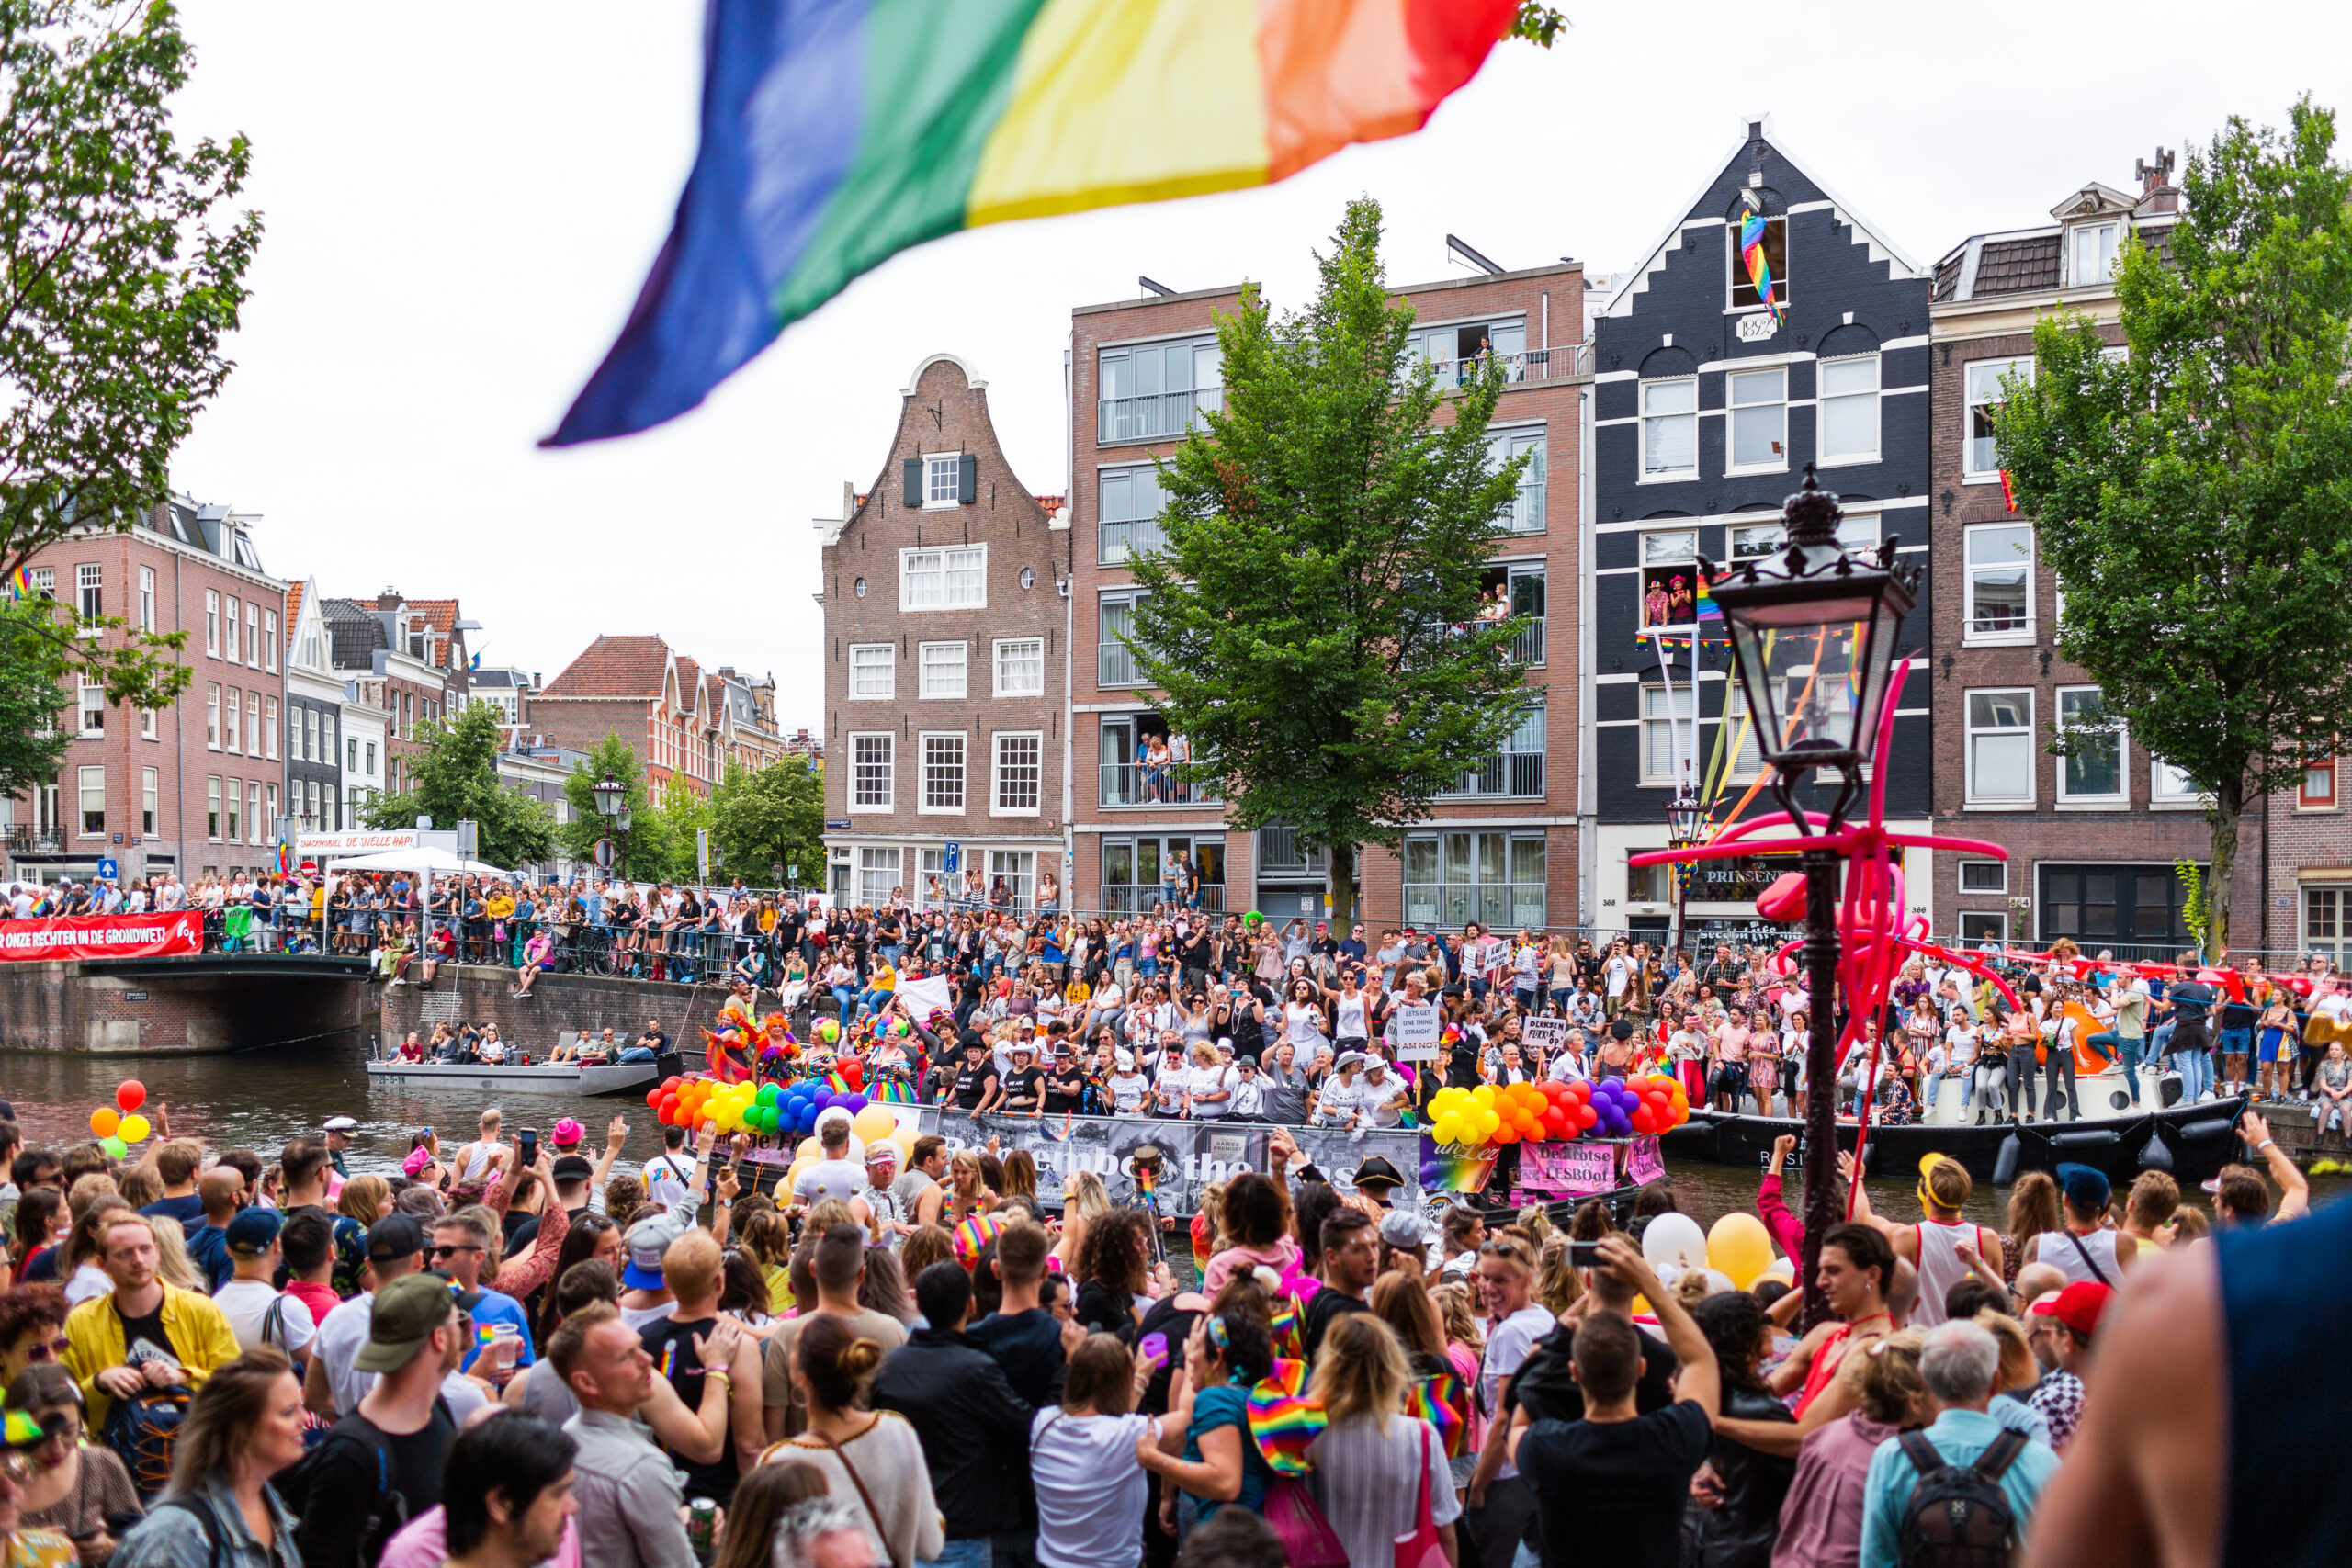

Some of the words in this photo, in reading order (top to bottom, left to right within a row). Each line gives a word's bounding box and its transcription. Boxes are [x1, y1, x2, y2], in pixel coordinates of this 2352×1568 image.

[346, 837, 357, 847] DE
[359, 836, 390, 847] SNELLE
[392, 835, 413, 847] HAP!
[948, 844, 957, 860] P
[1911, 906, 1927, 914] 366
[6, 931, 31, 948] ONZE
[32, 930, 77, 947] RECHTEN
[78, 929, 88, 945] IN
[90, 929, 104, 944] DE
[106, 926, 165, 944] GRONDWET!
[1530, 1021, 1564, 1030] DERKSEN
